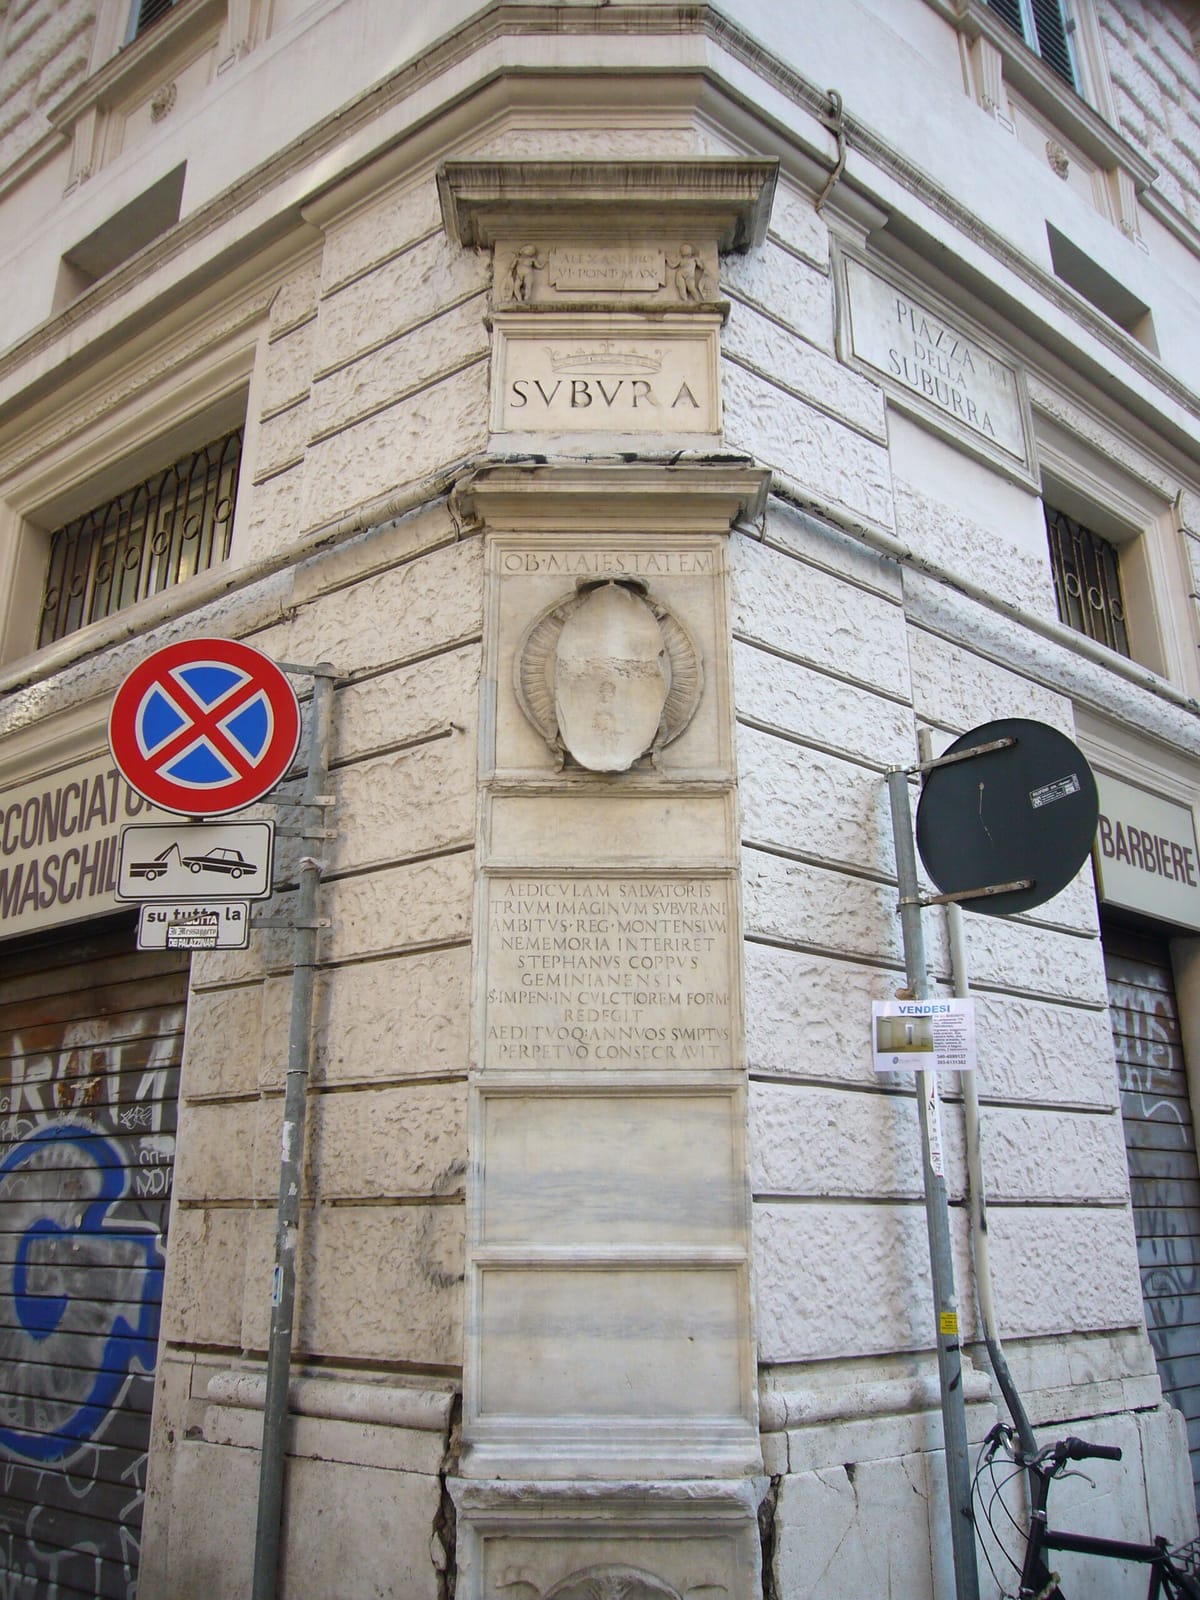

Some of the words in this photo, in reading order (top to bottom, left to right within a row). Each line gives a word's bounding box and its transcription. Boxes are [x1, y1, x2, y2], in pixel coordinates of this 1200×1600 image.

[896, 299, 976, 374] PIAZZA
[914, 340, 968, 390] DELLA
[510, 379, 700, 409] SVBVRA
[889, 348, 996, 437] SUBURRA
[0, 769, 153, 856] CONCIATU
[1099, 814, 1198, 888] BARBIERE
[0, 834, 118, 920] MASCHIL
[504, 883, 610, 897] AEDICVLAM
[619, 884, 712, 898] SALVATORIS
[147, 912, 167, 922] su
[225, 907, 241, 921] la
[490, 901, 551, 914] TRIVM
[556, 901, 648, 915] IMAGINVM
[652, 902, 726, 916] SVBVRANI
[618, 938, 716, 952] INTERIRET
[517, 955, 621, 969] STEPHANVS
[629, 956, 699, 969] COPPVS
[521, 973, 683, 987] GEMINIANENSIS
[564, 1009, 644, 1022] REDEGIT
[898, 1004, 951, 1015] VENDESI
[499, 1044, 589, 1059] PERPETVO
[595, 1045, 720, 1059] CONSECRAVIT
